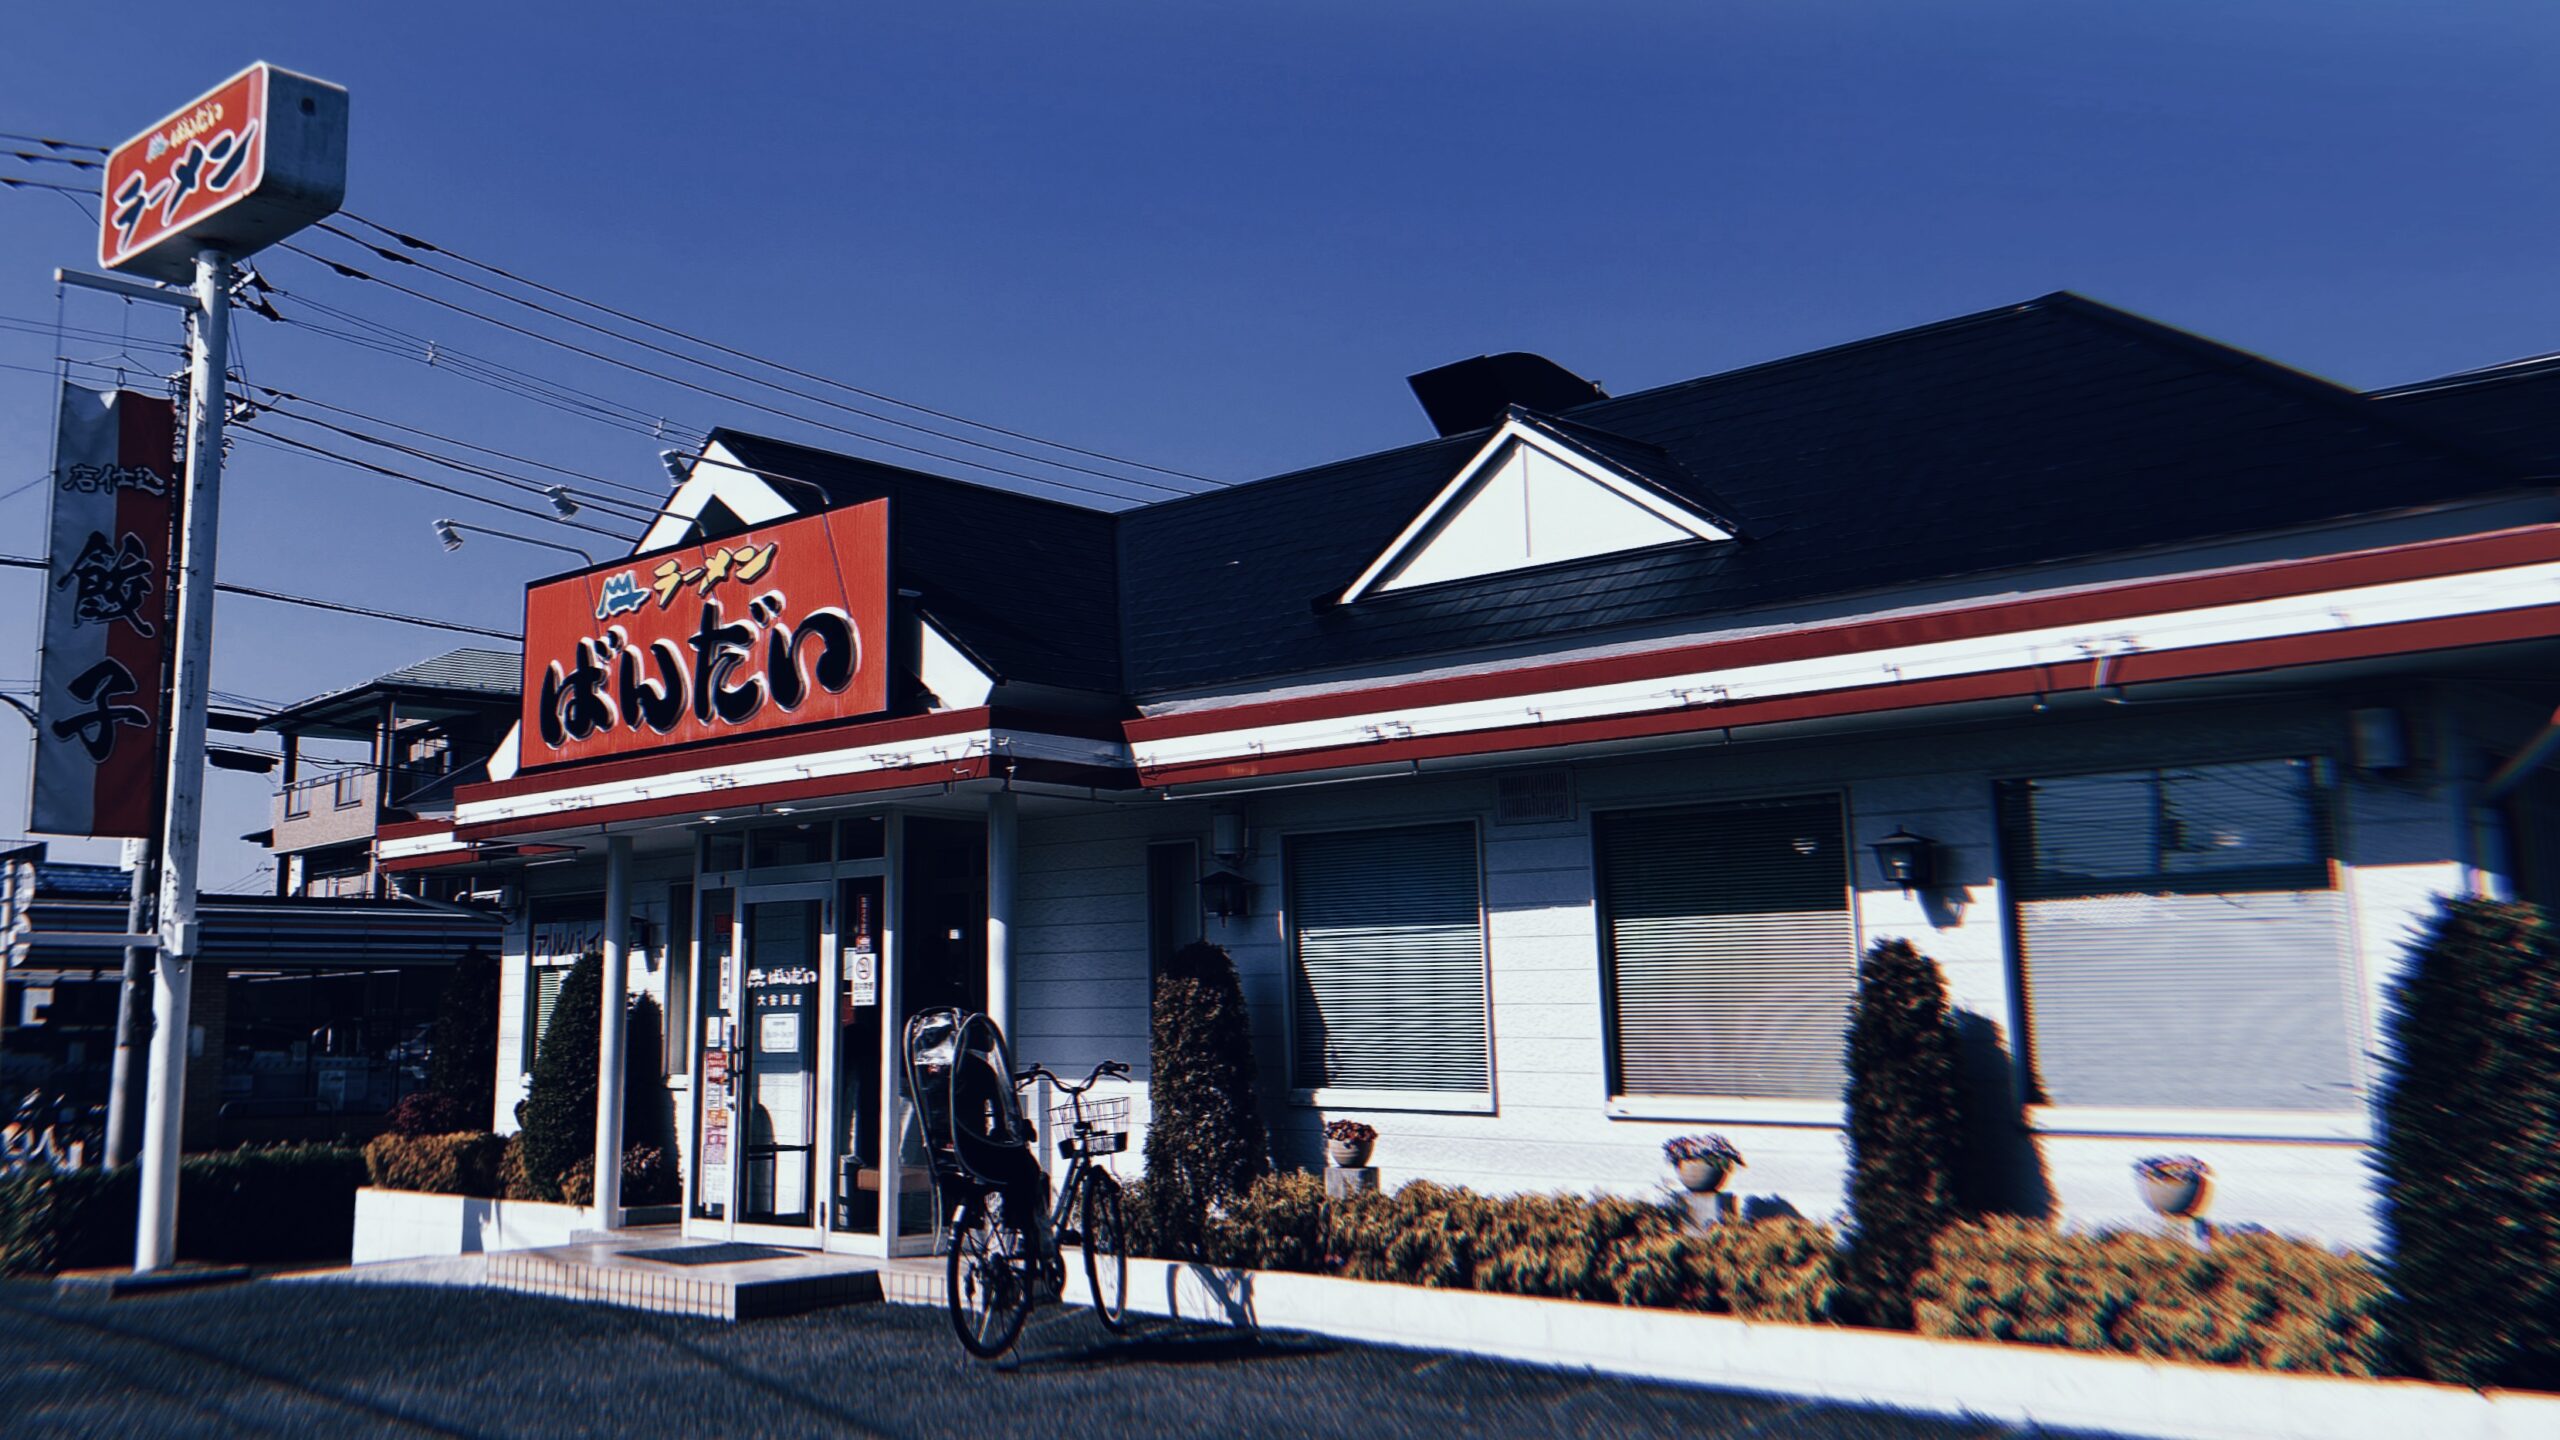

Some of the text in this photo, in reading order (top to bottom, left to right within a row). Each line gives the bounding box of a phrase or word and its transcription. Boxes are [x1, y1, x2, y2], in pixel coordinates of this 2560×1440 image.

[169, 102, 224, 148] ばんだい
[112, 118, 258, 255] ラーメン
[61, 463, 167, 497] 店仕込
[652, 541, 780, 610] ラーメン
[51, 529, 156, 764] 餃子
[540, 589, 863, 750] ばんだい
